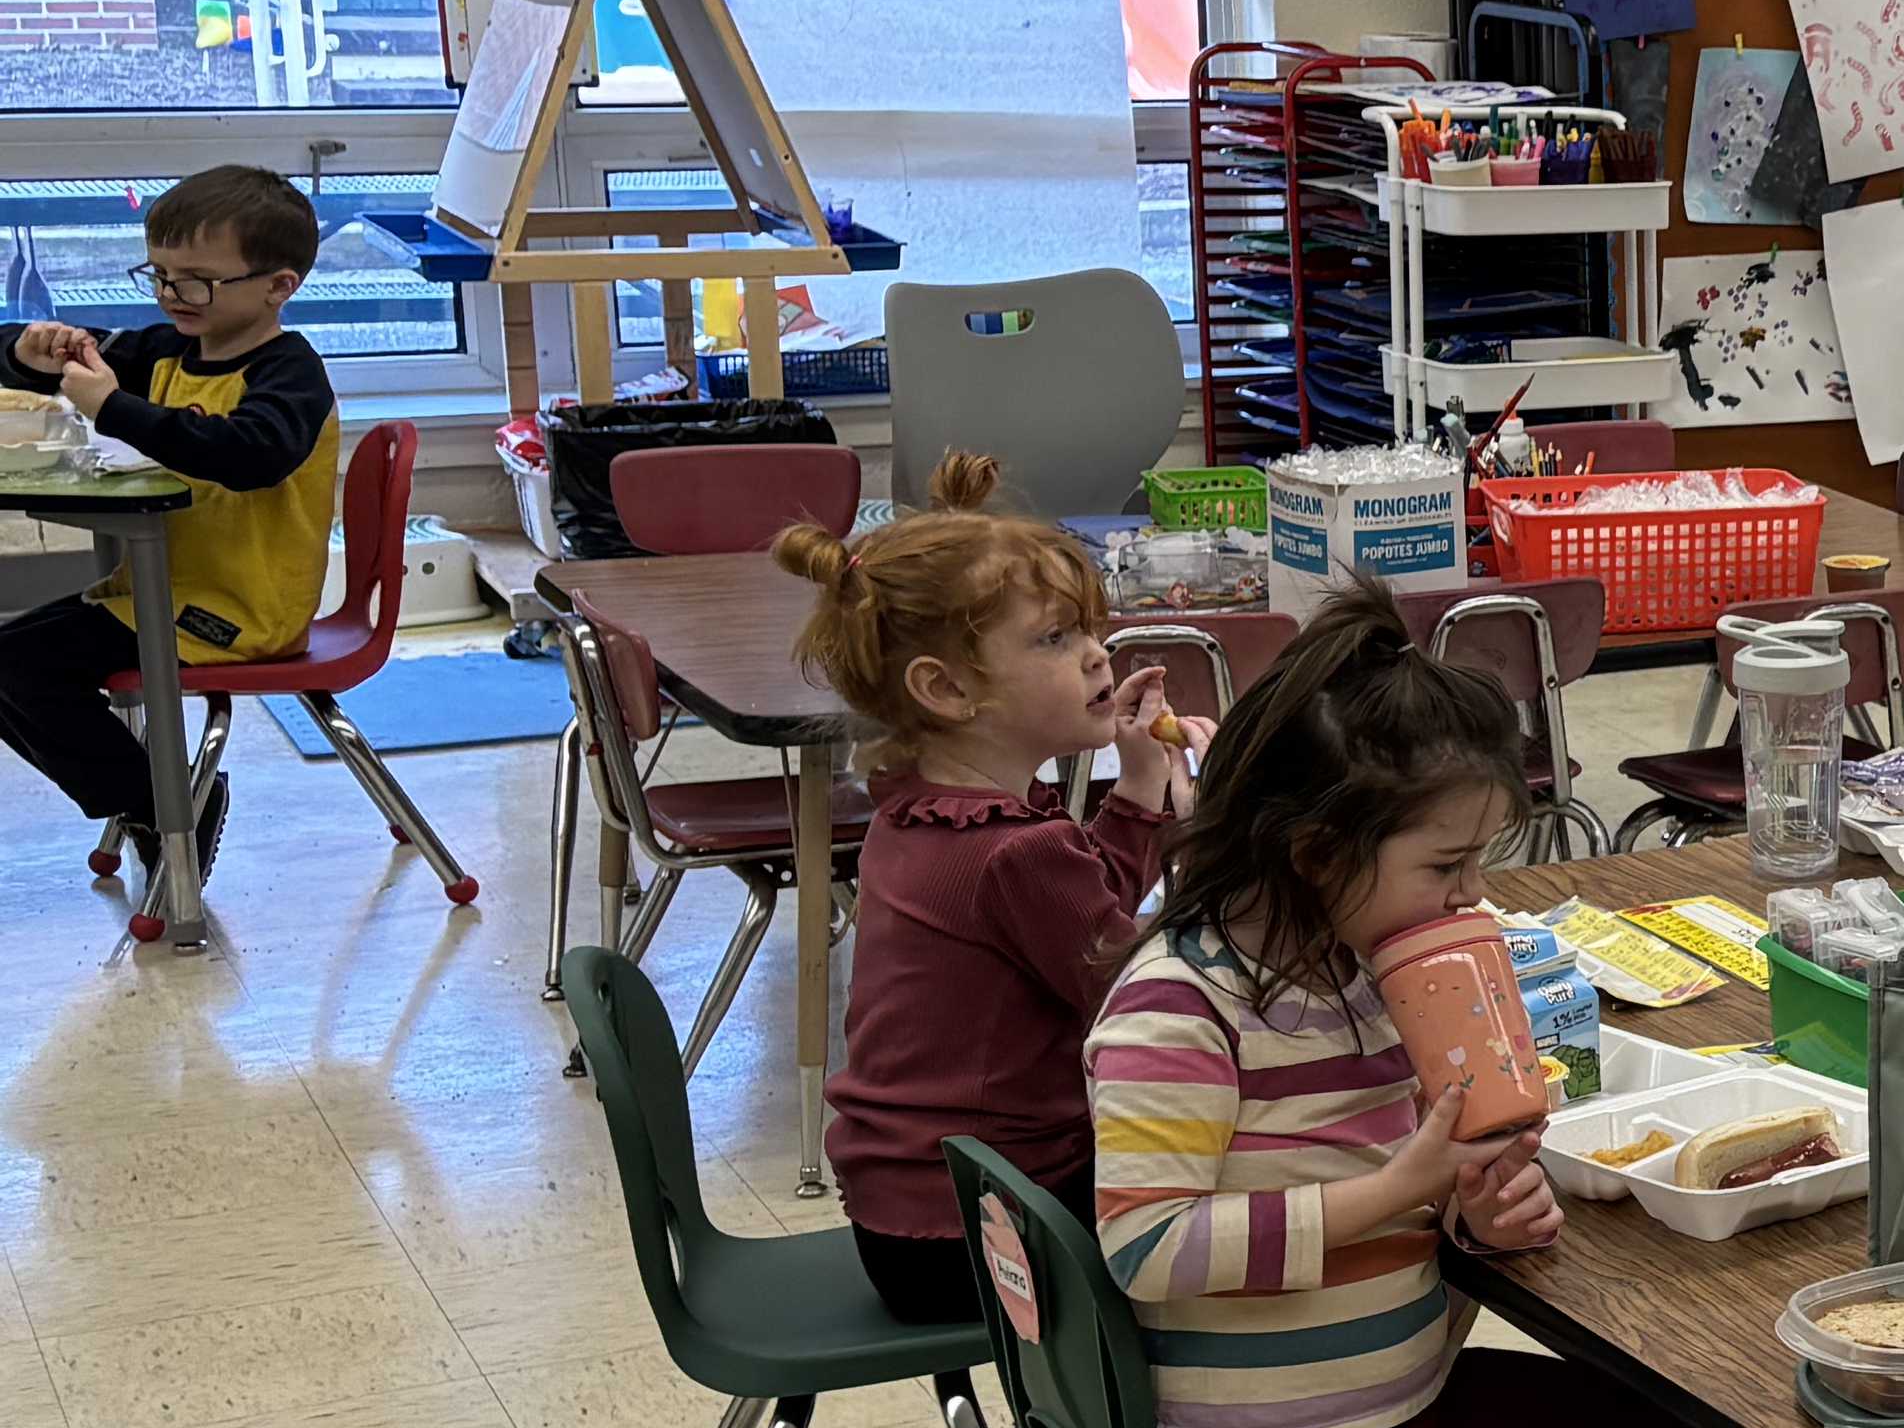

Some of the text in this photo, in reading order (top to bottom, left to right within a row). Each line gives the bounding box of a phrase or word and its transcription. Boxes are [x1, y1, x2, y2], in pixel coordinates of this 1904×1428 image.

[1270, 485, 1324, 517] MONOGRAM
[1354, 491, 1451, 519] MONOGRAM
[1362, 539, 1449, 561] POPOTES JUMBO
[1552, 1012, 1572, 1029] 1%
